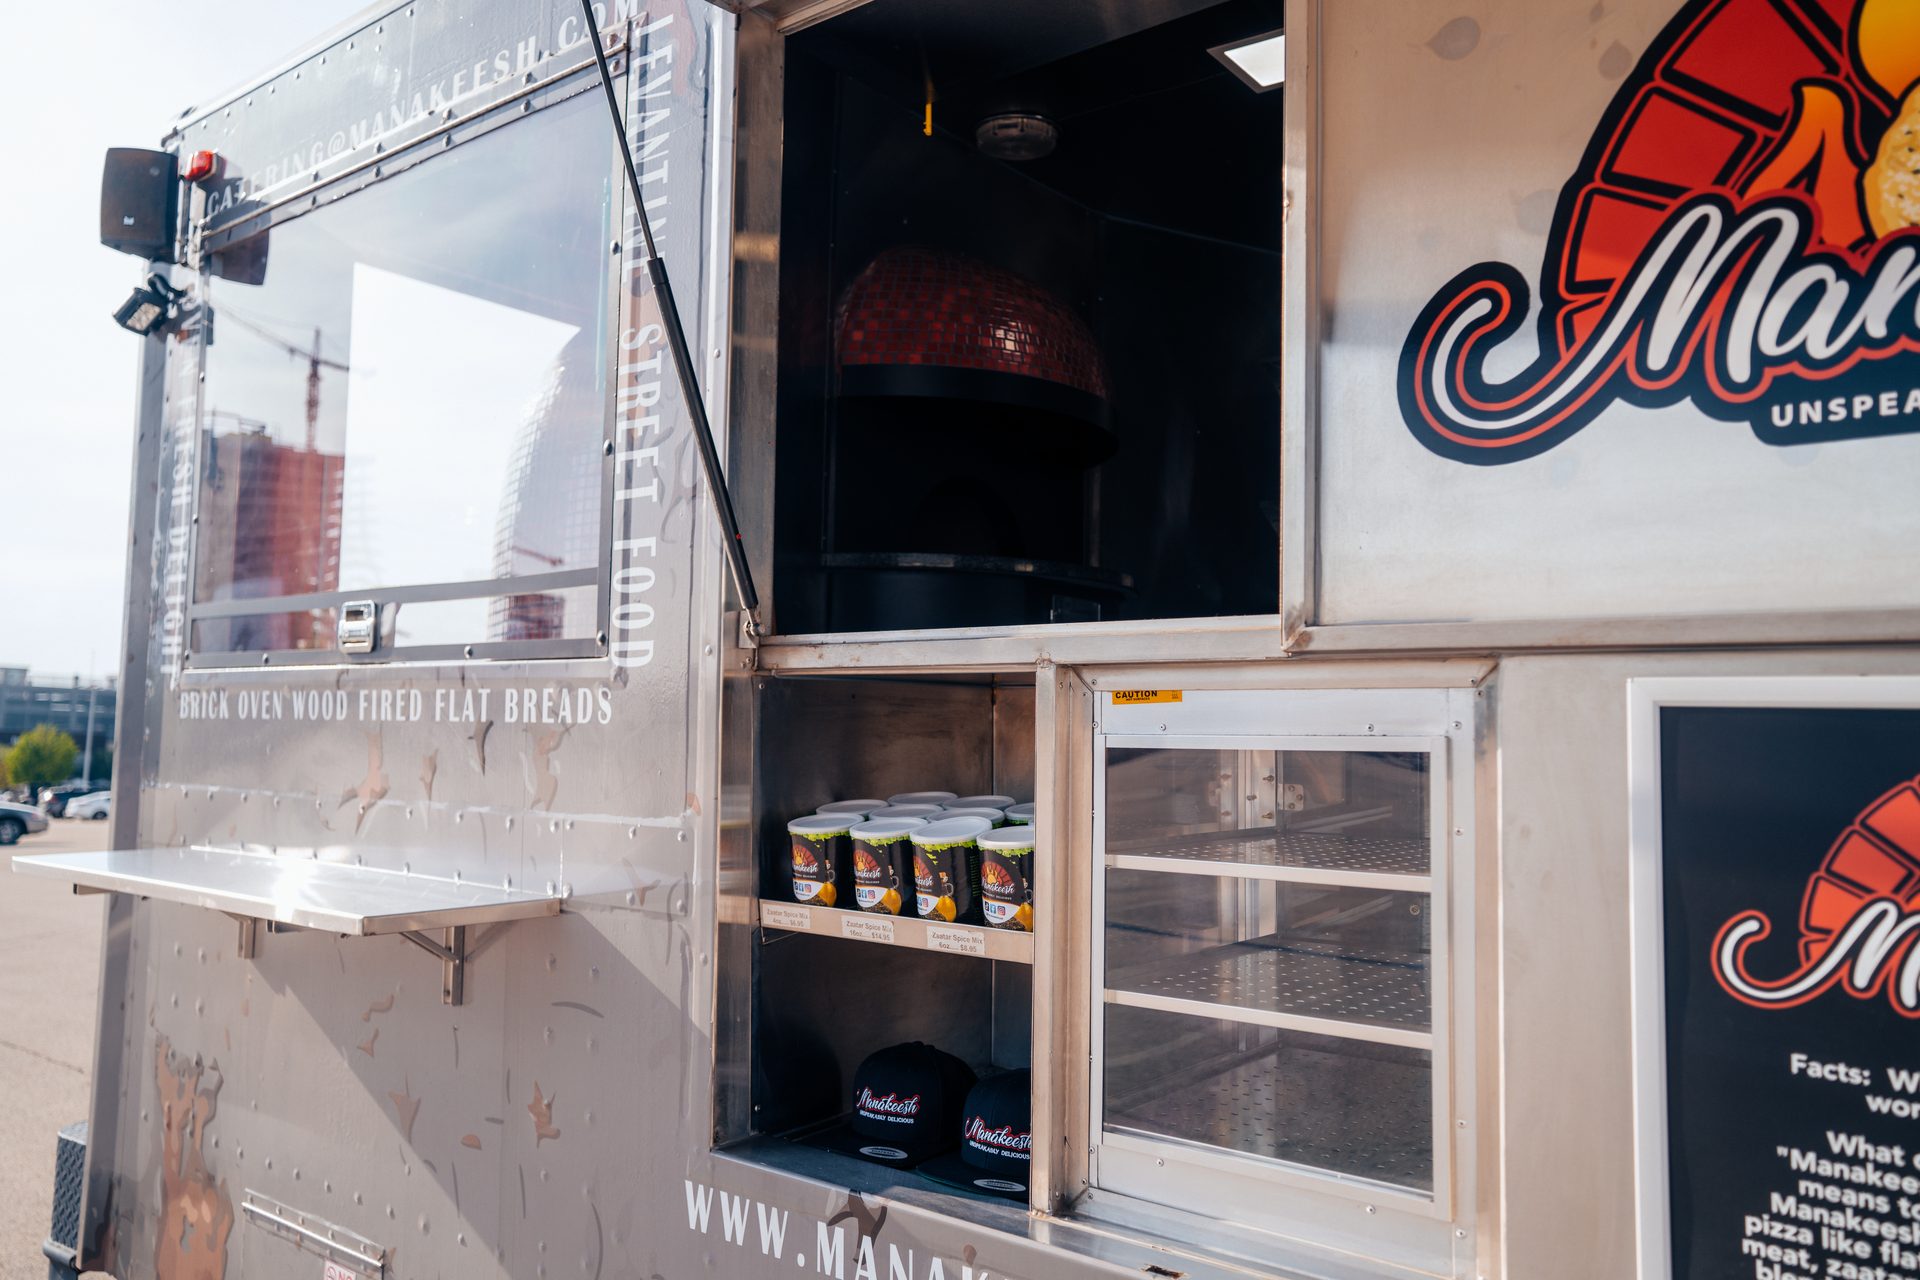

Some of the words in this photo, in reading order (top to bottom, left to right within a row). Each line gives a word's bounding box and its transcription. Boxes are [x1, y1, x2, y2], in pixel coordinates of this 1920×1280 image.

[615, 323, 663, 503] STREET
[611, 535, 656, 668] FOOD
[179, 690, 231, 721] BRICK
[237, 689, 283, 721] OVEN
[292, 689, 348, 721] WOOD
[359, 687, 423, 722] FIRED
[434, 686, 491, 723] FLAT
[504, 687, 612, 725] BREADS
[1115, 690, 1158, 698] CAUTION
[932, 932, 952, 940] Zaatar
[953, 934, 970, 943] Spice
[1789, 1052, 1871, 1087] Facts:
[856, 1088, 919, 1114] Manakeesh
[887, 1116, 915, 1125] DELICIOUS
[1826, 1130, 1906, 1168] What
[1798, 1180, 1891, 1214] means
[1744, 1213, 1814, 1246] pizza
[1821, 1226, 1872, 1259] like
[1742, 1238, 1818, 1274] meat,
